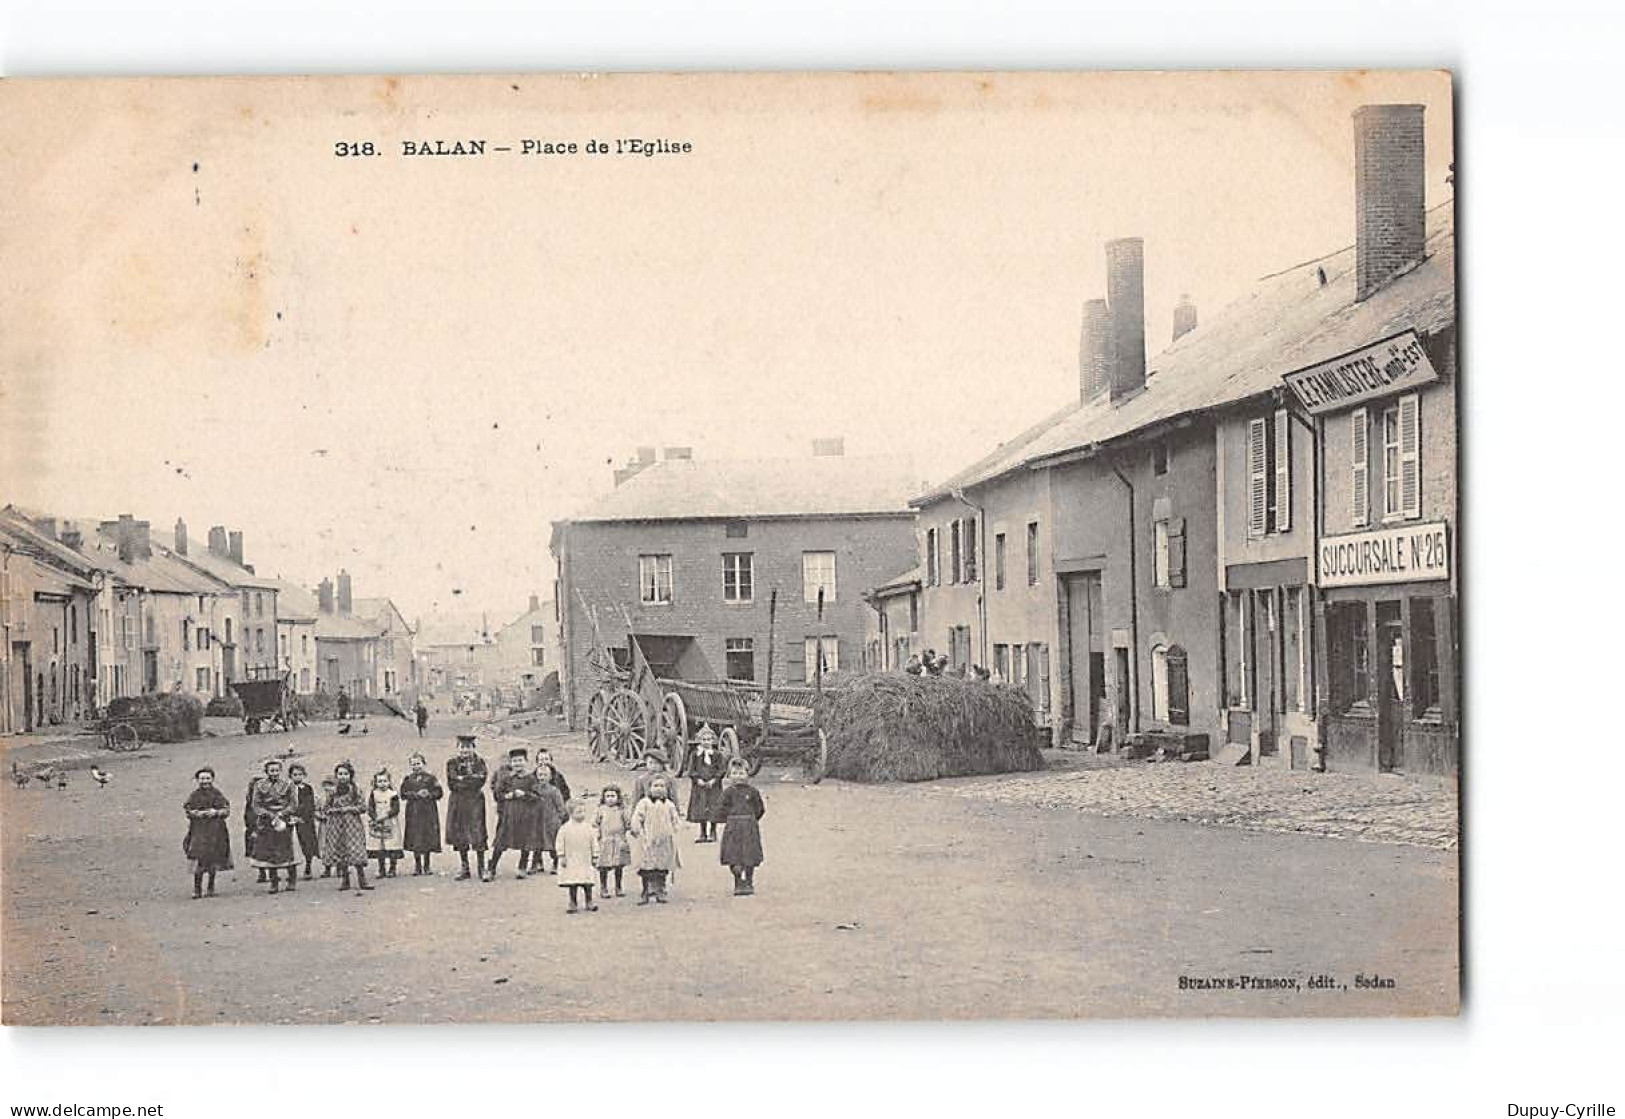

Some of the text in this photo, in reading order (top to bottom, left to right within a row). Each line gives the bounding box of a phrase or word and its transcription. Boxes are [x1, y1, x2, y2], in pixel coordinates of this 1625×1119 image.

[334, 142, 382, 157] 318.
[402, 141, 486, 156] BALAN
[520, 139, 578, 155] Place
[586, 139, 609, 155] de
[616, 138, 692, 157] l'Eglise
[1290, 379, 1319, 407] LE
[1322, 536, 1406, 577] SUCCURSALE
[1425, 531, 1445, 569] 215
[1307, 973, 1348, 991] édit.,
[1354, 974, 1396, 990] Sedan
